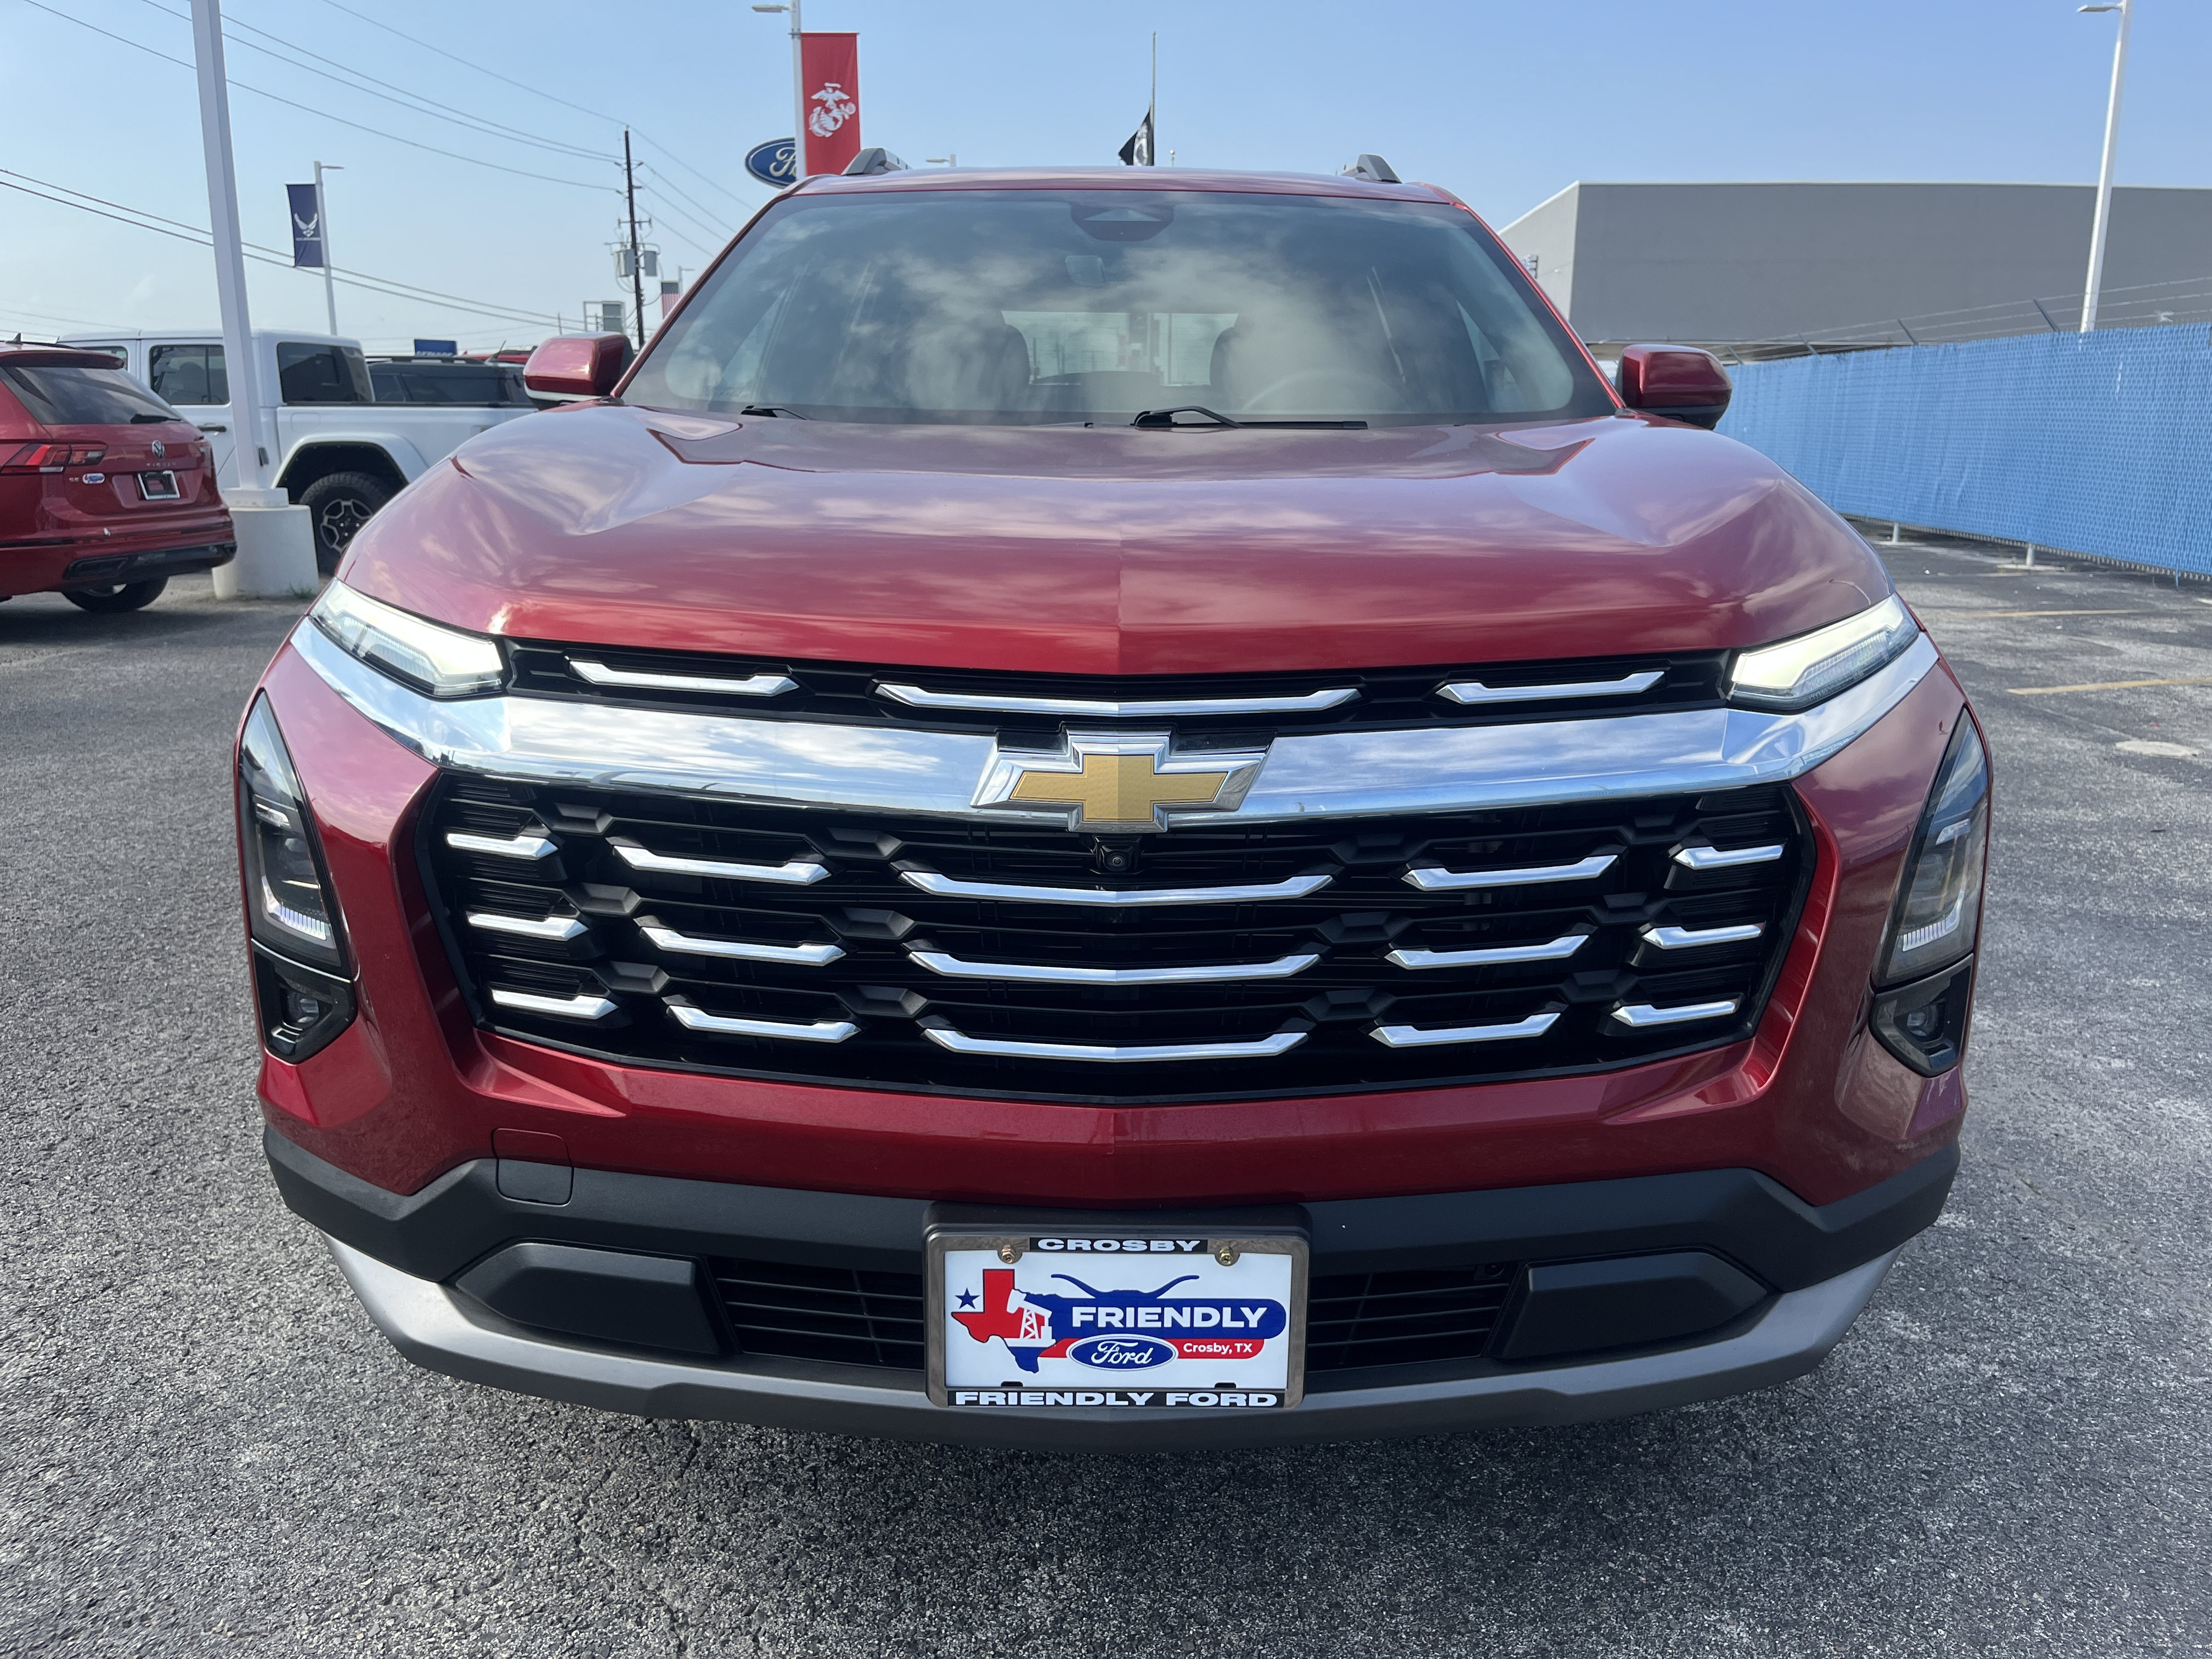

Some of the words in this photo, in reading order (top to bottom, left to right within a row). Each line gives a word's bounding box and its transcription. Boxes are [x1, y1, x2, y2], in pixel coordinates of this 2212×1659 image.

[1037, 1238, 1201, 1252] CROSBY
[1072, 1306, 1268, 1328] FRIENDLY
[1091, 1340, 1154, 1364] Ford
[1183, 1342, 1233, 1355] Crosby,
[1234, 1342, 1253, 1353] TX
[955, 1391, 1155, 1407] FRIENDLY
[1166, 1392, 1278, 1407] FORD
